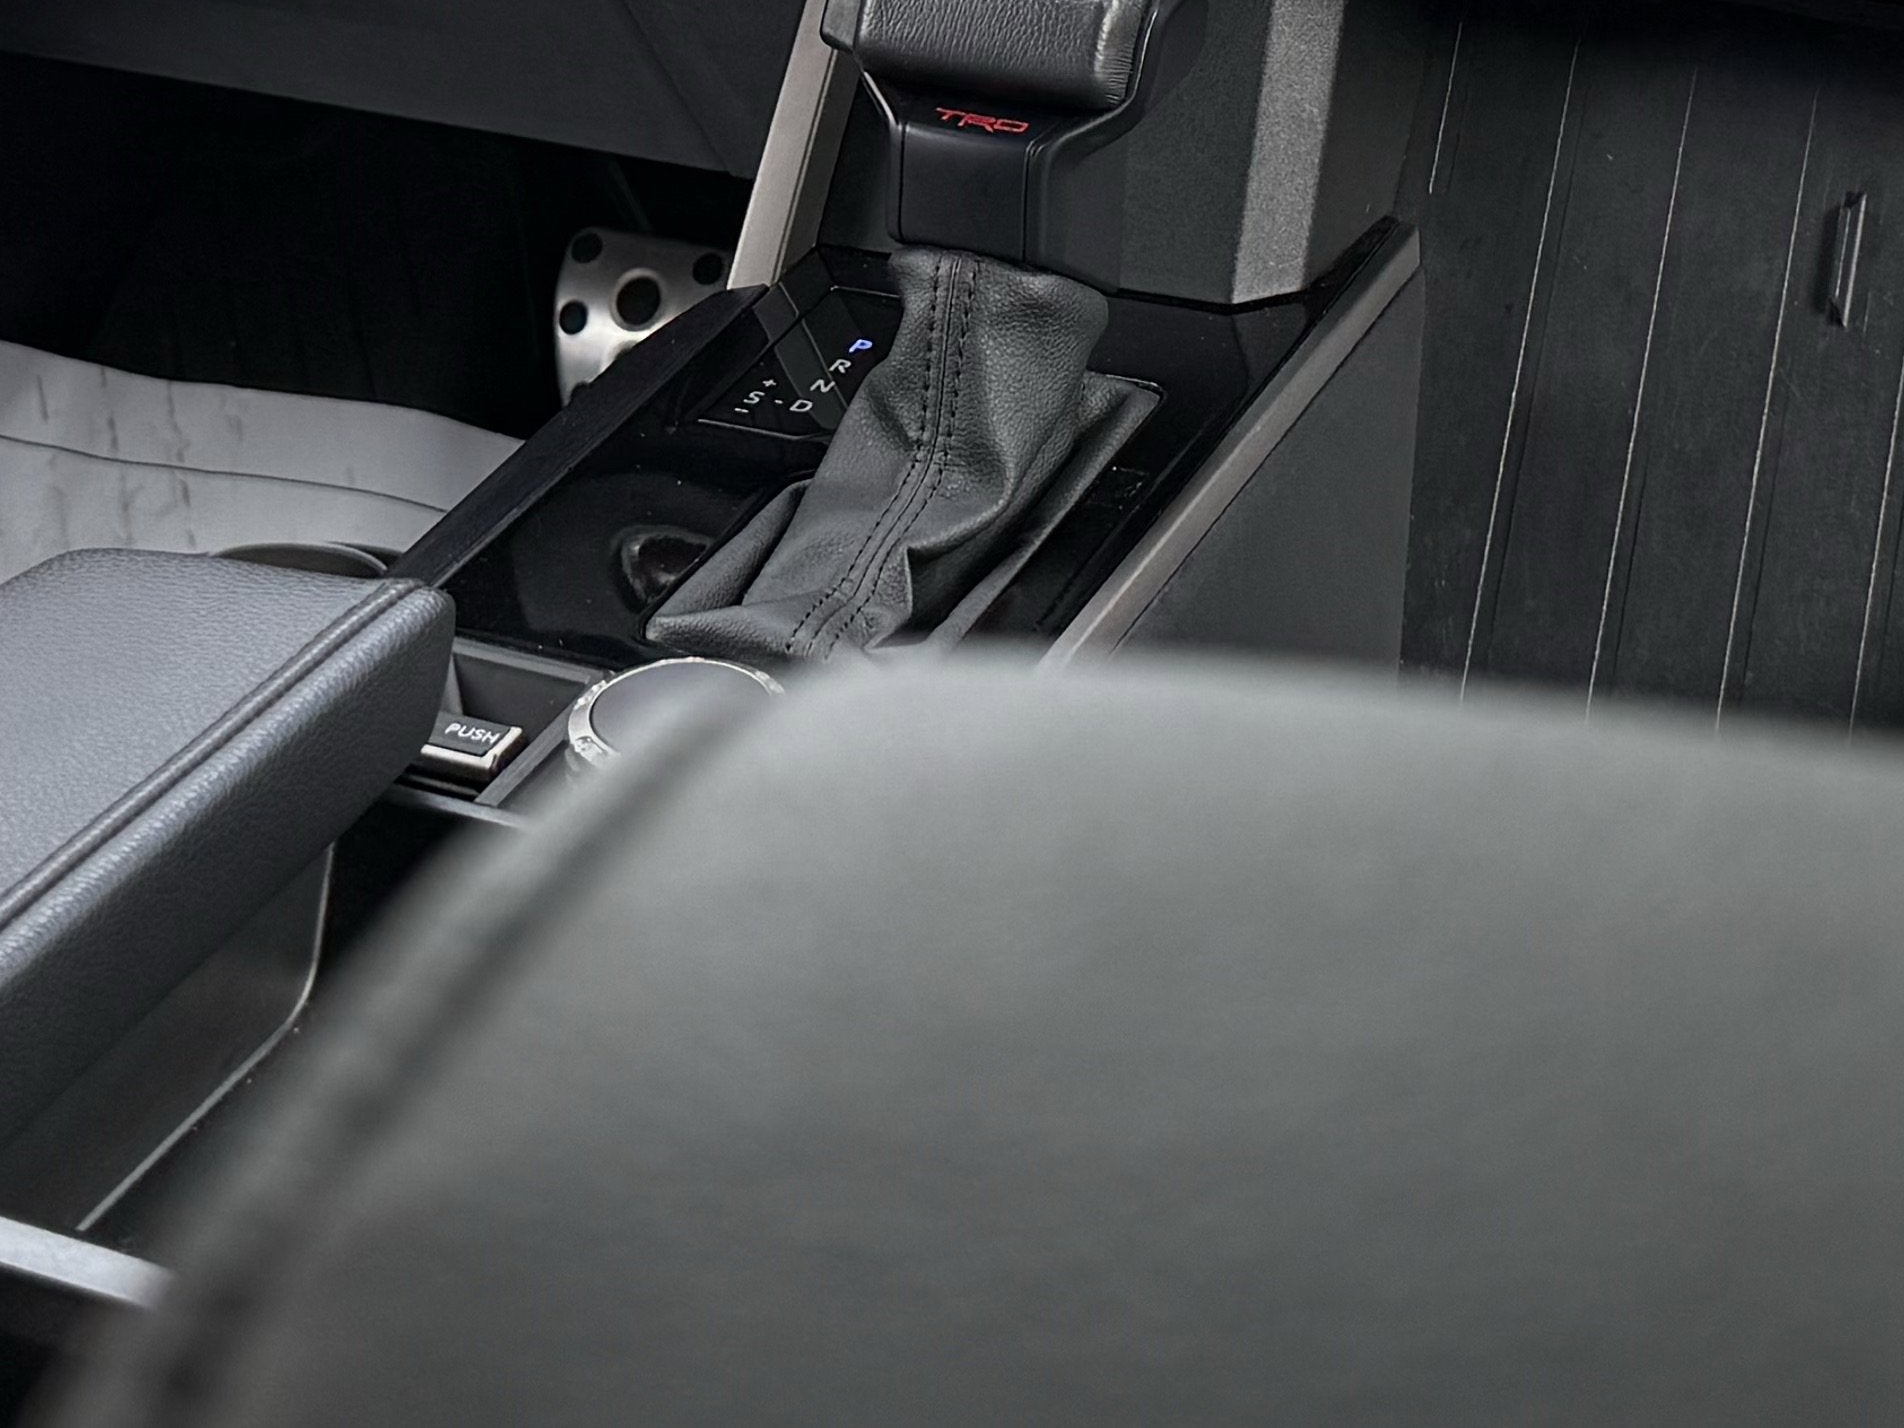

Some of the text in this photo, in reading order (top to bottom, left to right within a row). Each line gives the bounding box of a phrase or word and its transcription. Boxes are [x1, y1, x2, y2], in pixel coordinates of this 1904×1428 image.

[936, 107, 1029, 133] TRD
[848, 339, 873, 353] P
[828, 358, 852, 374] R
[809, 379, 836, 393] N
[743, 390, 766, 405] S
[789, 399, 814, 413] D
[444, 722, 501, 744] PUSH
